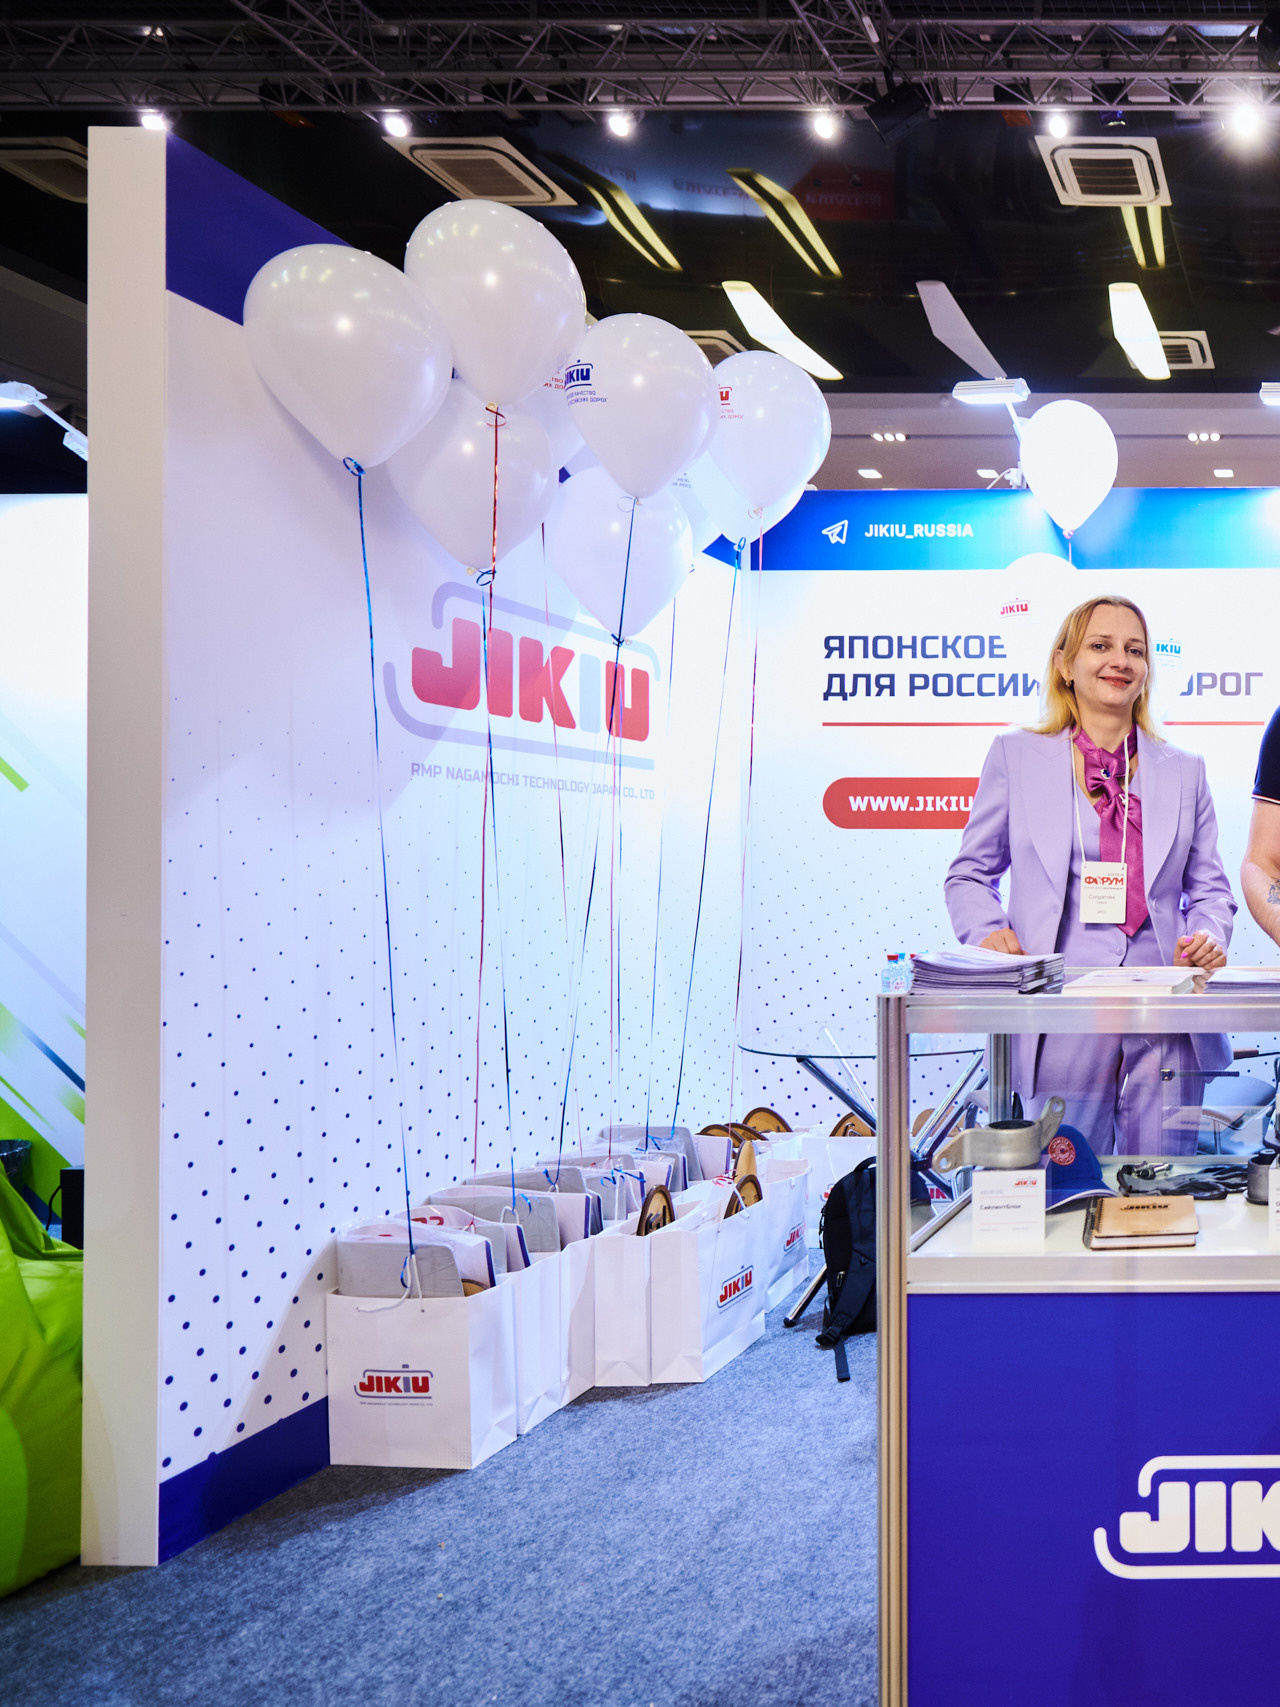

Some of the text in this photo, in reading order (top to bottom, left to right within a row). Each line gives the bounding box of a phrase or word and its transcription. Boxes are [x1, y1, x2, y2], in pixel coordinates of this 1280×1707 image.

[864, 523, 974, 539] JIKIU_RUSSIA
[823, 635, 1007, 659] ЯПОНСКОЕ
[411, 617, 650, 742] JIKIU
[822, 673, 895, 701] ДЛЯ
[1179, 672, 1264, 696] РОГ
[411, 762, 442, 779] RMP
[446, 765, 520, 787] NAGAMOCHI
[523, 775, 590, 793] TECHNOLOGY
[592, 783, 620, 797] JAPAN
[719, 1265, 753, 1303] JIKIU
[359, 1364, 430, 1393] JIKIU
